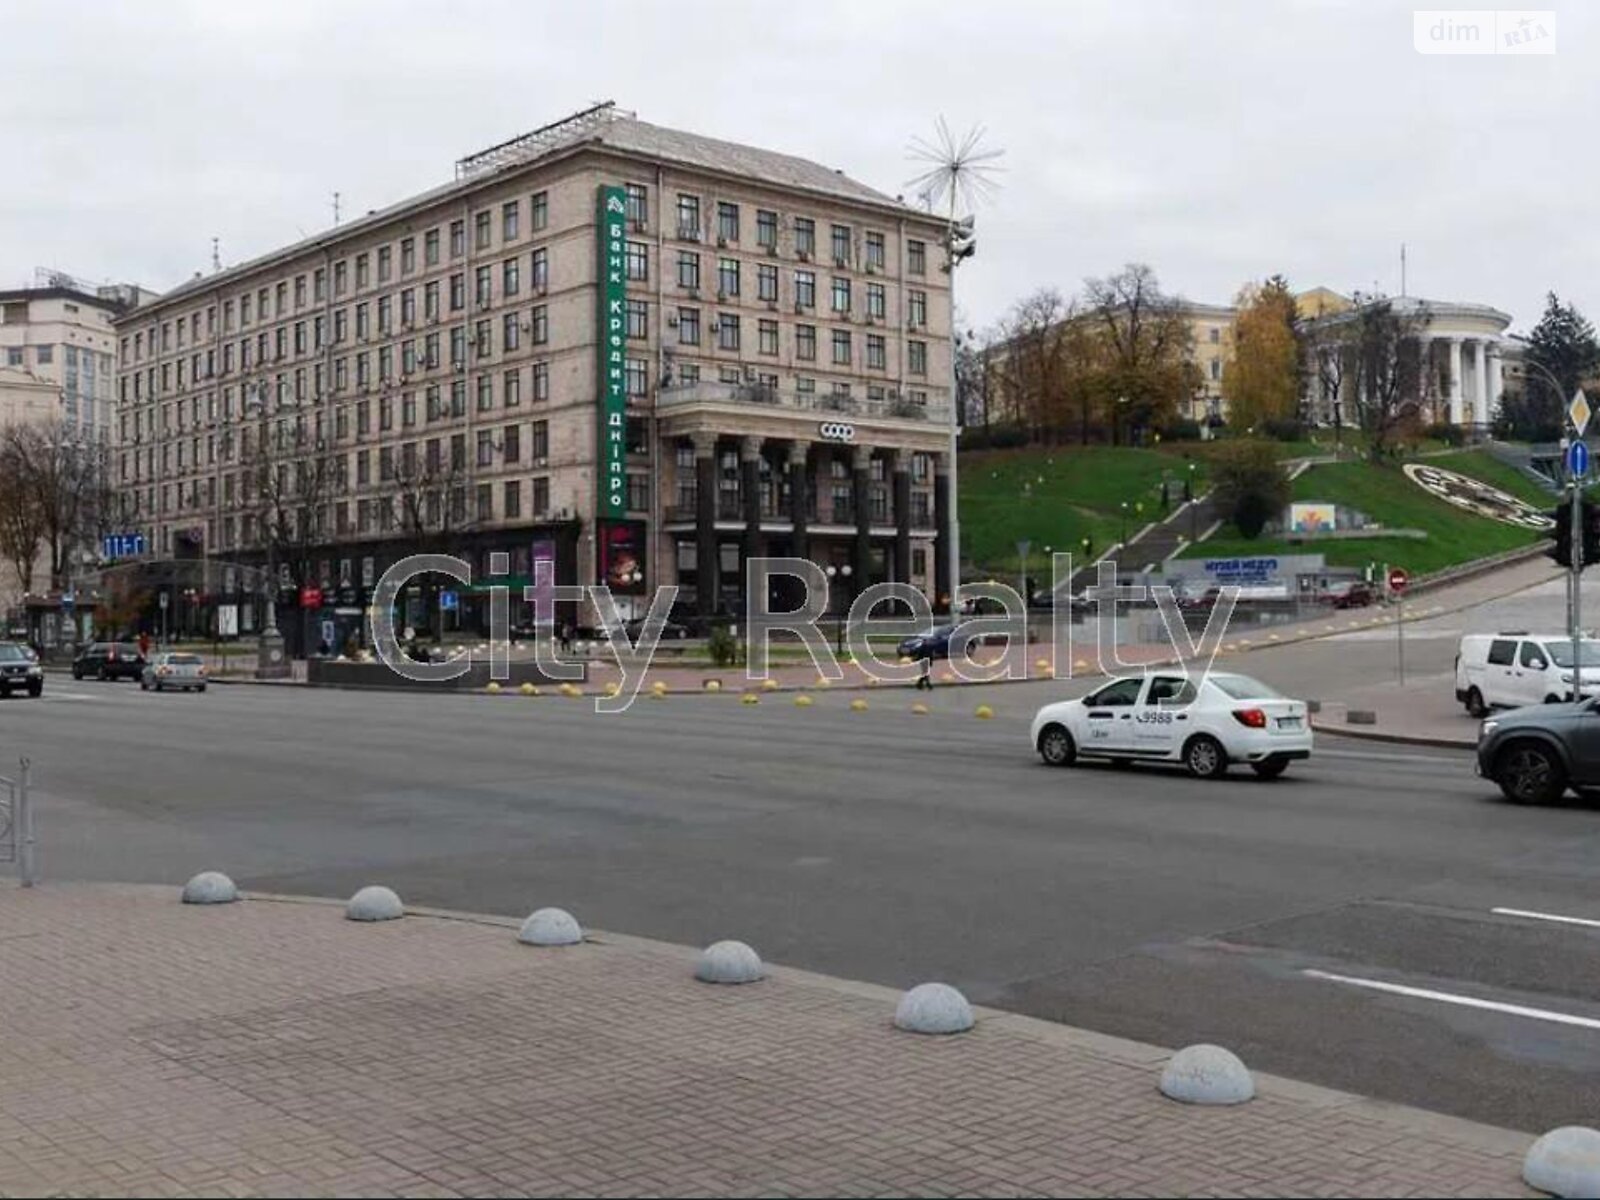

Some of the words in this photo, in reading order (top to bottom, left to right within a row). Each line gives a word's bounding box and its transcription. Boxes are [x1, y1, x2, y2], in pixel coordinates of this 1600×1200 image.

[609, 224, 622, 284] Банк
[609, 301, 622, 396] Кредит
[608, 412, 622, 506] Дніпро
